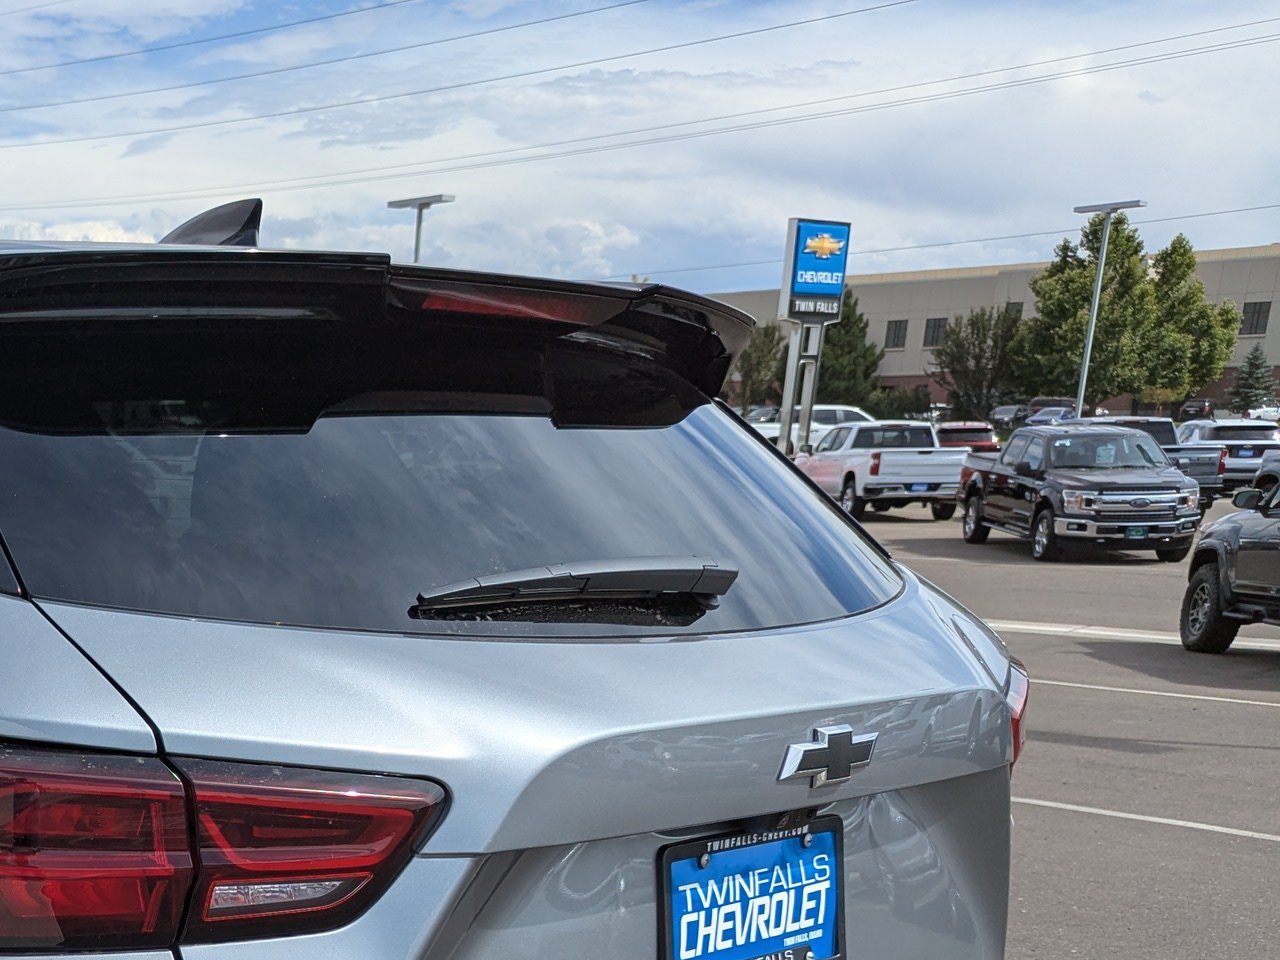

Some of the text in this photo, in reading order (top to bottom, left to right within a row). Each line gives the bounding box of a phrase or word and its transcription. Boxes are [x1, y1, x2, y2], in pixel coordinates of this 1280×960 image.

[797, 270, 842, 284] CHEVROLET
[795, 301, 838, 313] TWIN FALLS
[678, 854, 831, 912] TWINFALLS
[680, 880, 831, 960] CHEVROLET
